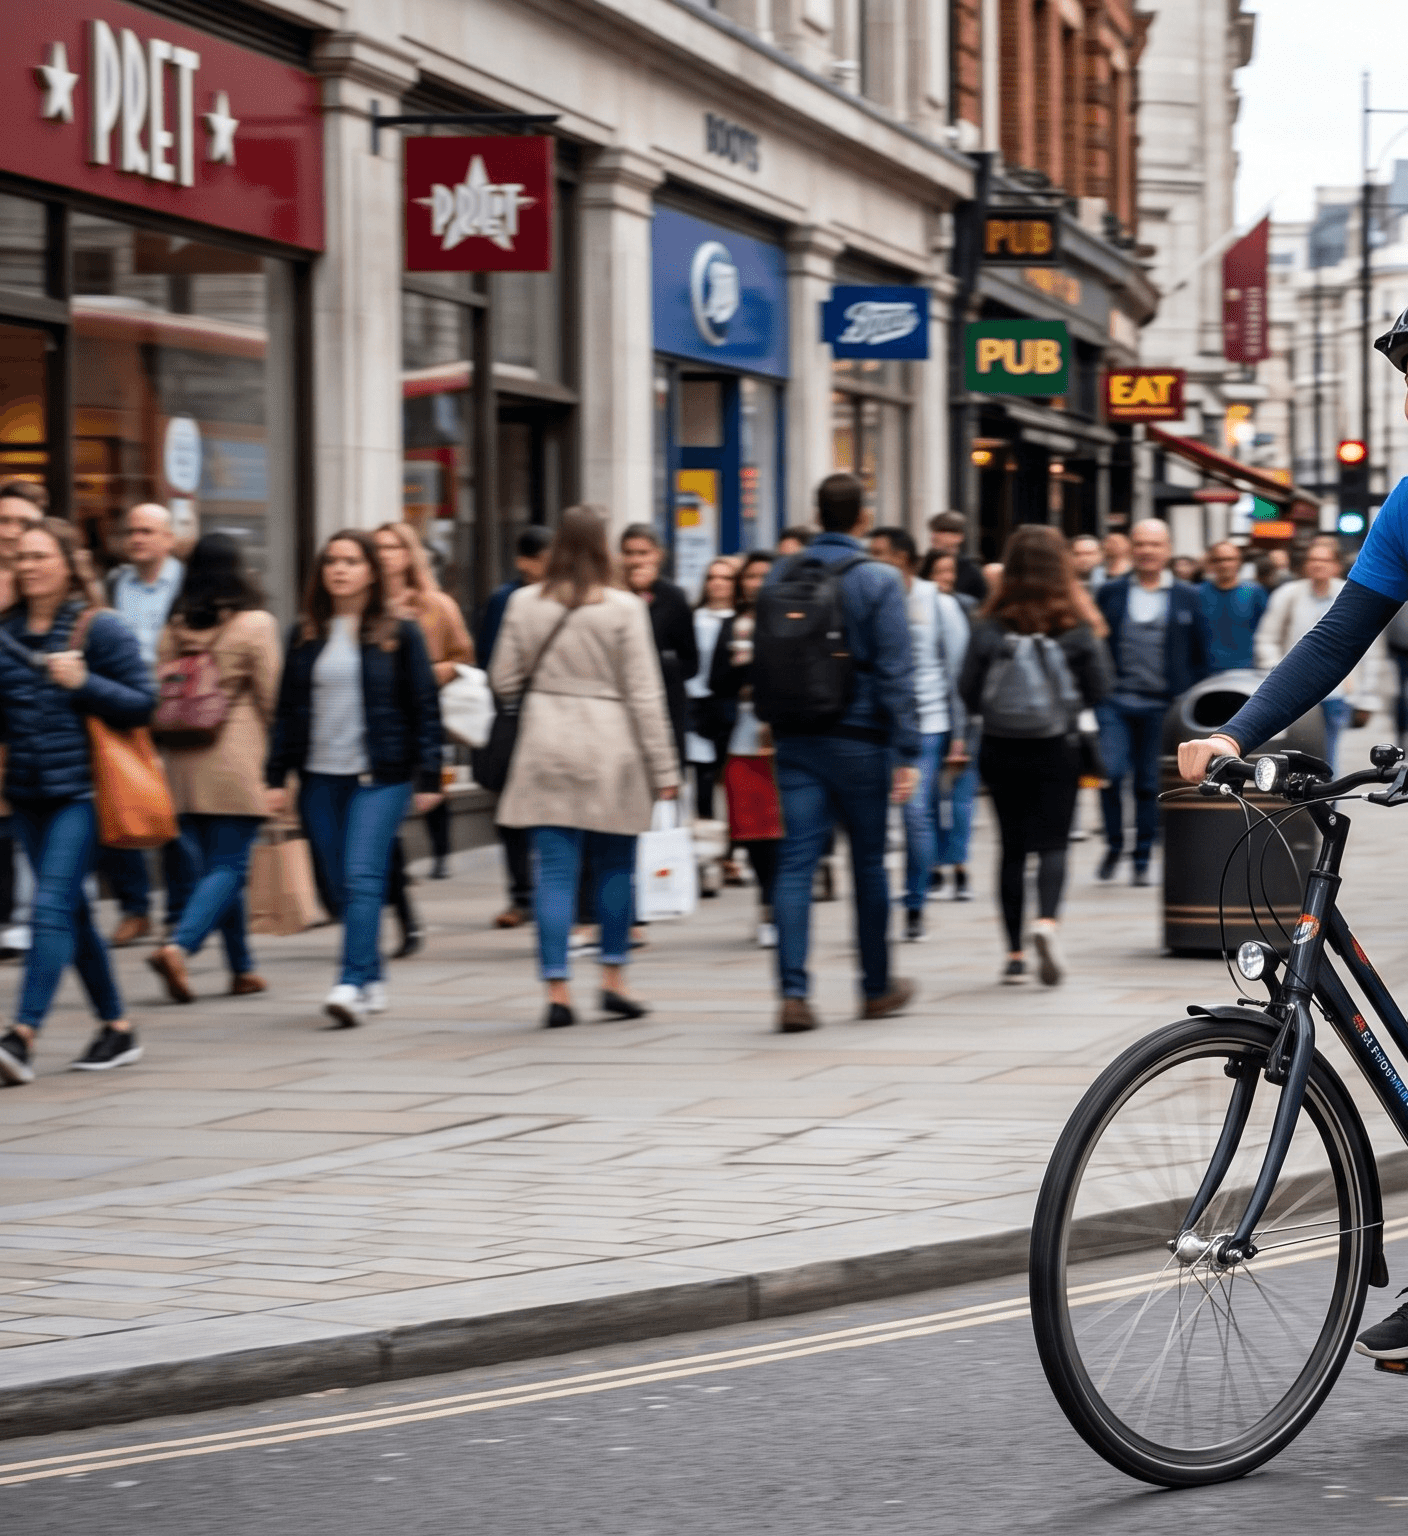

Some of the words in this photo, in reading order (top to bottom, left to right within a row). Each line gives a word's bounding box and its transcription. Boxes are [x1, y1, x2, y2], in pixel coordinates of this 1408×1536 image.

[91, 19, 200, 187] PRET
[430, 183, 526, 236] PRET
[985, 219, 1051, 254] PUB
[976, 337, 1063, 375] PUB
[1109, 374, 1176, 405] EAT
